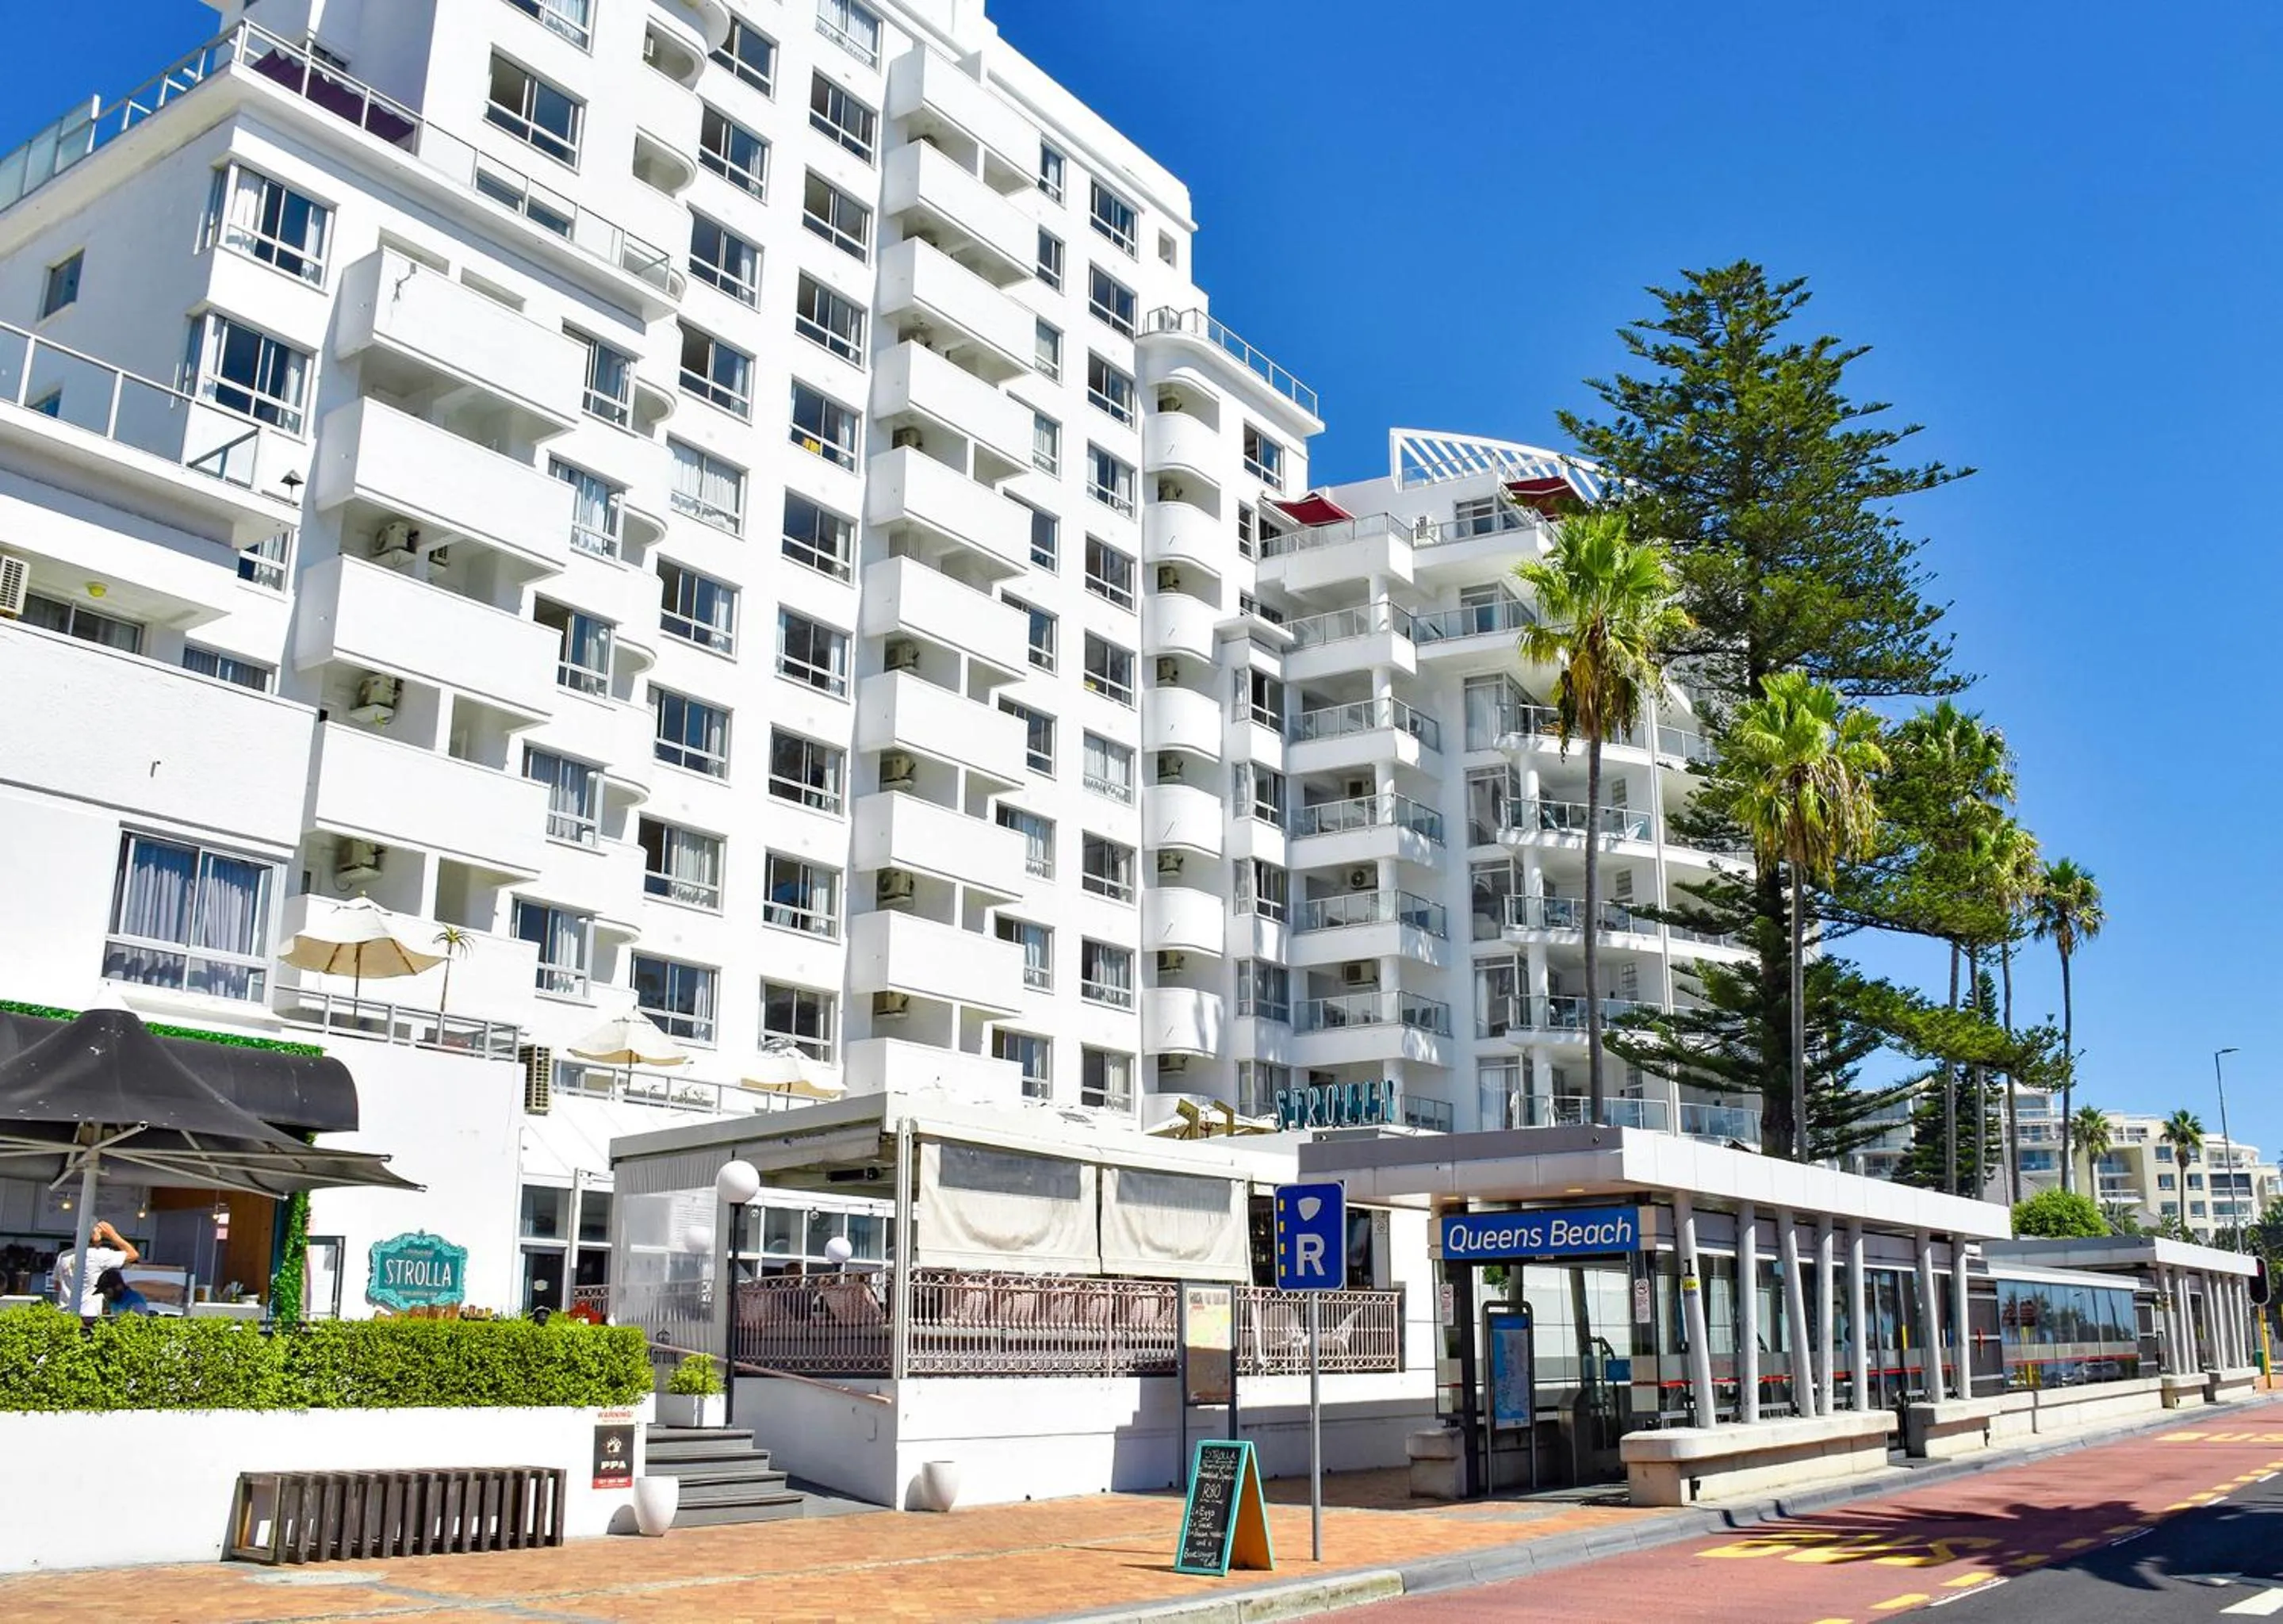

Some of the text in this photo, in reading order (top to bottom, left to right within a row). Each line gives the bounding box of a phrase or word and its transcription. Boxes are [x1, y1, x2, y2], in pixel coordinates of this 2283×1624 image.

[1276, 1080, 1394, 1129] STROLLA
[1449, 1216, 1632, 1253] Queens Beach
[385, 1258, 452, 1287] STROLLA
[1296, 1233, 1325, 1277] R
[1684, 1258, 1695, 1277] 1
